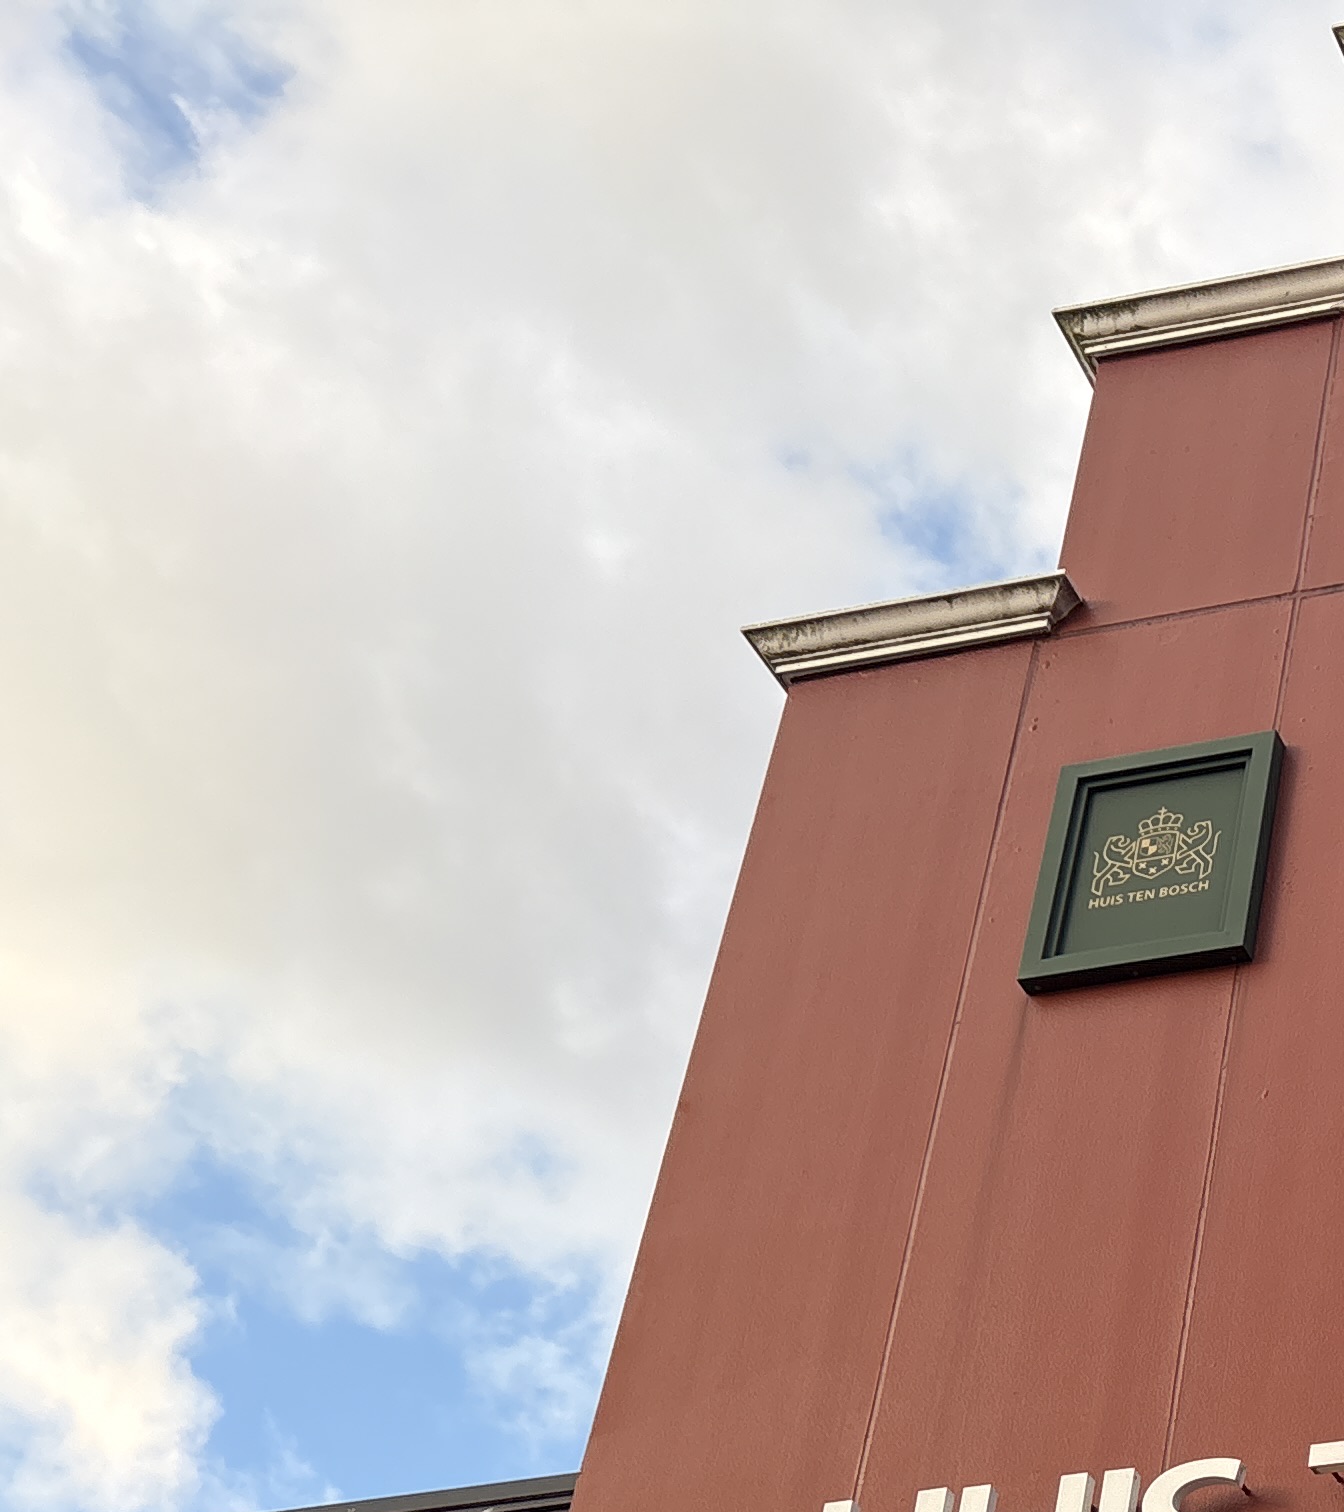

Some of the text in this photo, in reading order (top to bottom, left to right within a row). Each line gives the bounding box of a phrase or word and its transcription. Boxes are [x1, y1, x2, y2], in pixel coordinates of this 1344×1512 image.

[1088, 880, 1209, 909] HUIS TEN BOSCH
